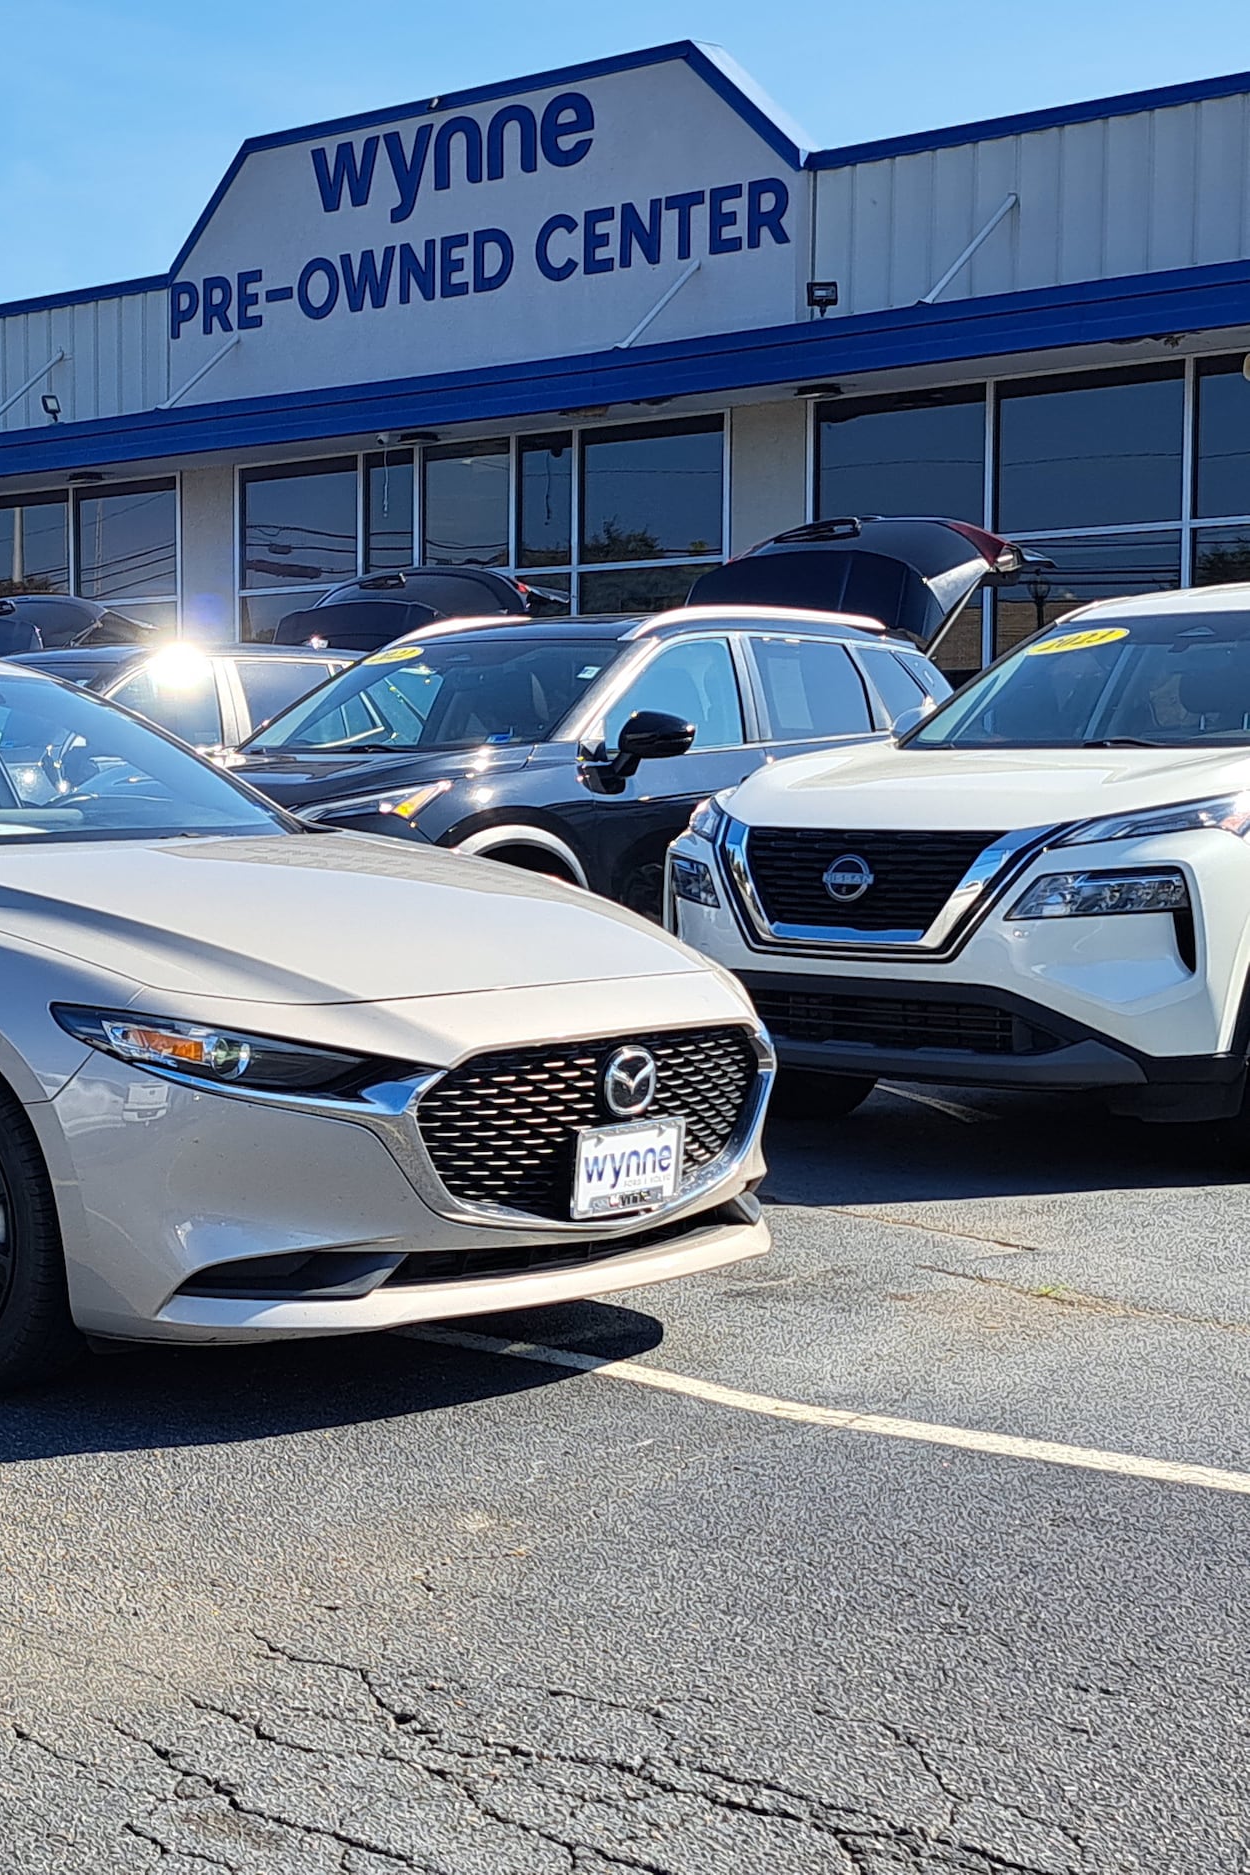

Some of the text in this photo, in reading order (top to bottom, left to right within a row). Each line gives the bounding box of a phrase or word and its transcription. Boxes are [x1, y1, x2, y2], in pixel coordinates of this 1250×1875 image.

[310, 92, 595, 224] wynne
[170, 177, 789, 340] PRE-OWNED CENTER
[584, 1145, 672, 1189] wynne
